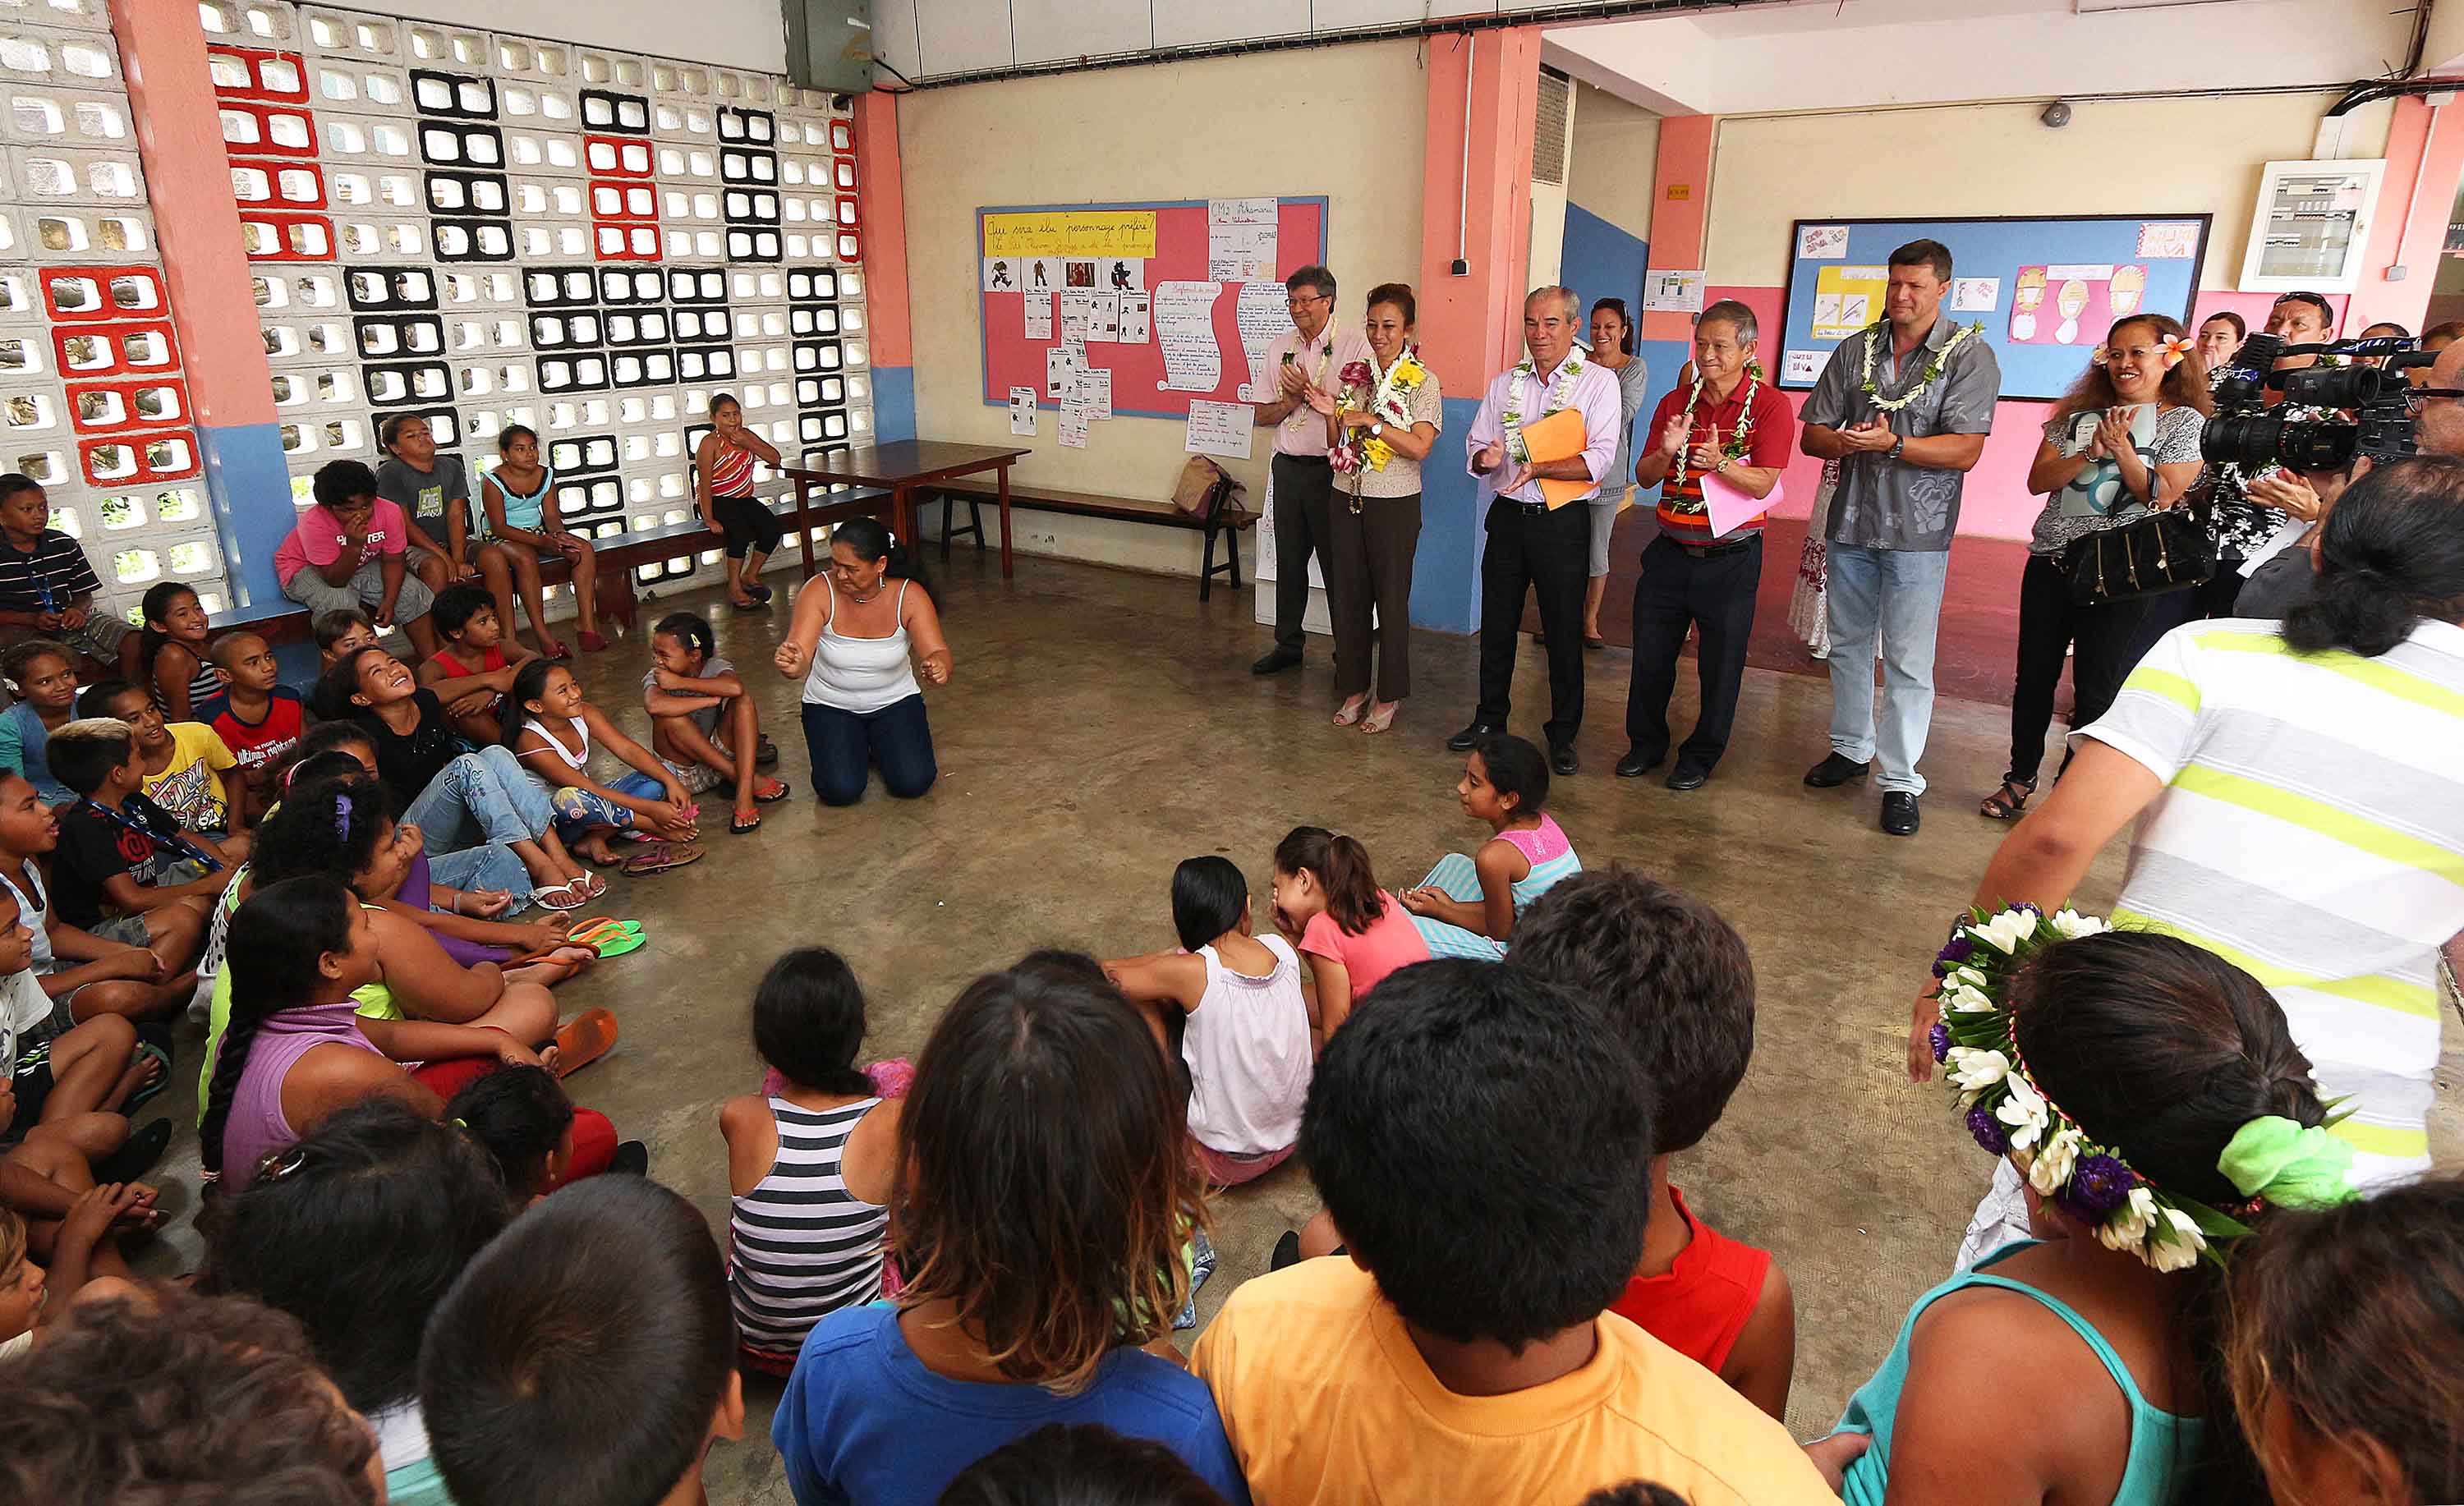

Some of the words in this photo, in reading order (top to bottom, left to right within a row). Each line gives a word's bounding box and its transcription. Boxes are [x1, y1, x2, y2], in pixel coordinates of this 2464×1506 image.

[986, 221, 1006, 249] Qui
[1066, 222, 1115, 243] personnage
[198, 808, 220, 828] 62
